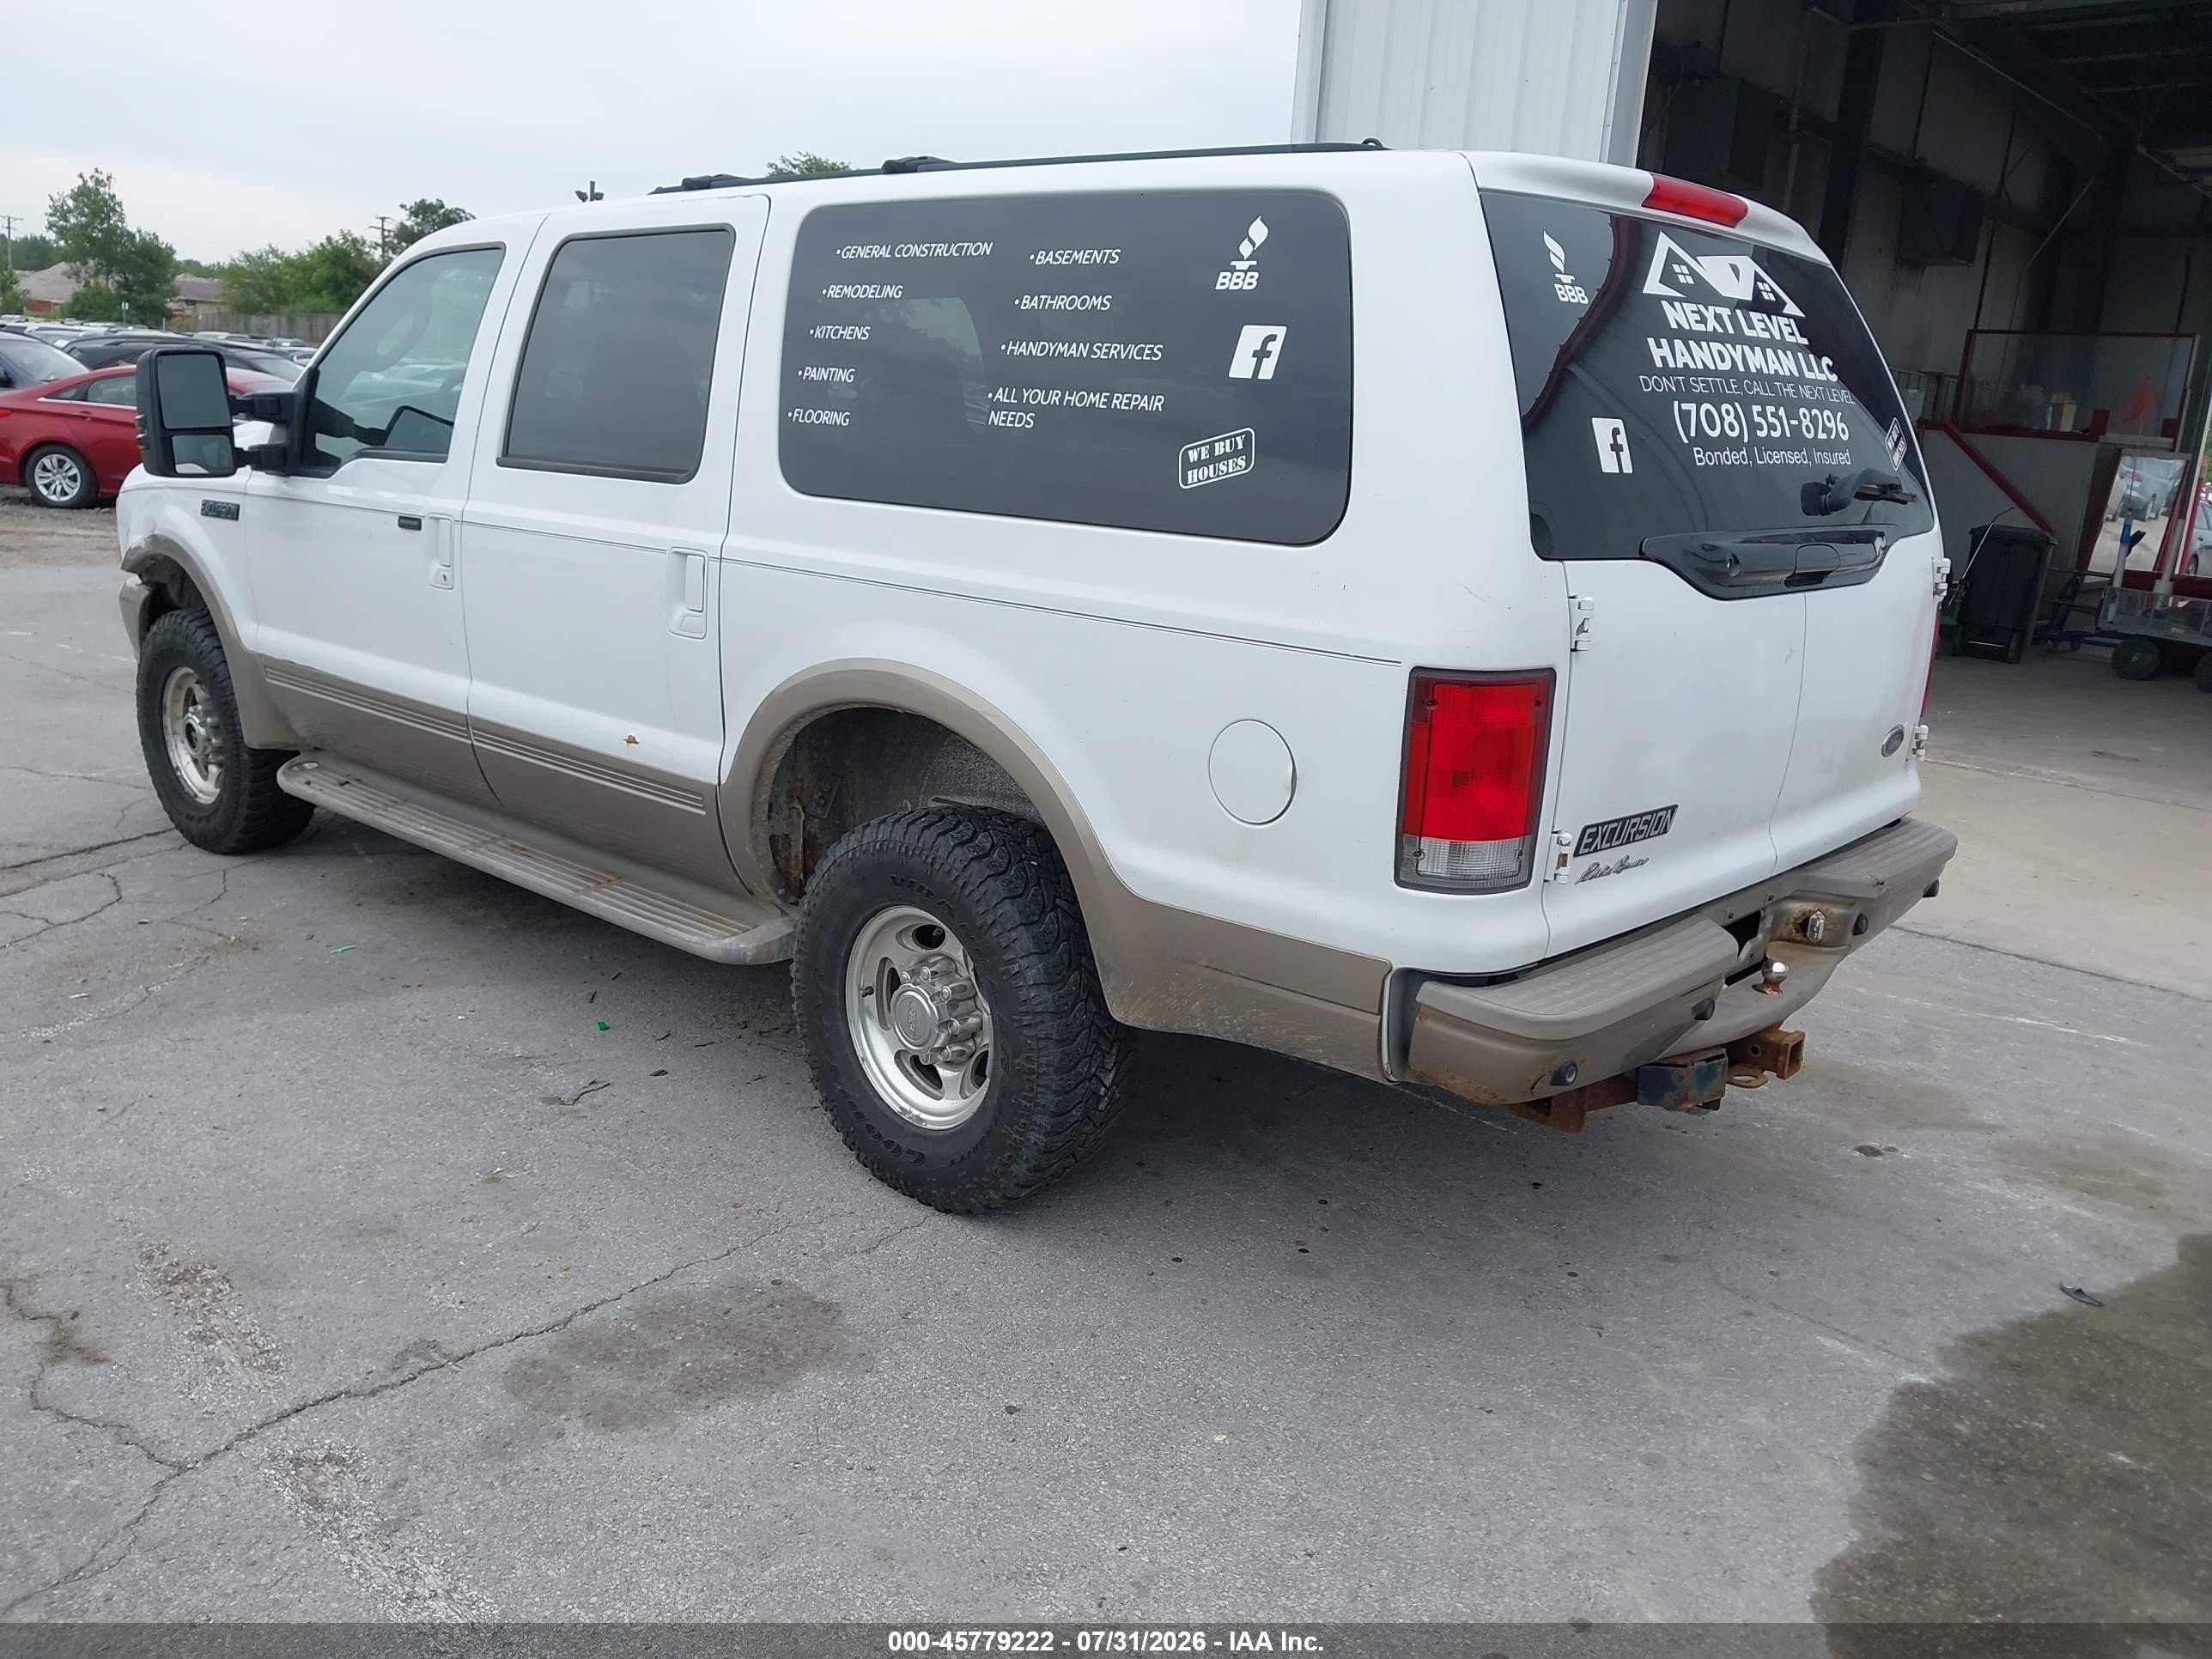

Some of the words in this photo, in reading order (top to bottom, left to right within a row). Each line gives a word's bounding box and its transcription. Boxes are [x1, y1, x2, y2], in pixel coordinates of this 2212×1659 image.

[842, 245, 891, 258] GENERAL
[894, 241, 994, 258] CONSTRUCTION
[1035, 249, 1121, 265] BASEMENTS
[1215, 270, 1260, 290] BBB
[827, 284, 903, 299] REMODELING
[1553, 283, 1589, 304] BBB
[1020, 295, 1112, 311] BATHROOMS
[814, 325, 871, 340] KITCHENS
[1661, 300, 1735, 335] NEXT
[1735, 308, 1809, 345] LEVEL
[1006, 341, 1090, 358] HANDYMAN
[1091, 343, 1164, 361] SERVICES
[1646, 337, 1800, 378] HANDYMAN
[1797, 351, 1838, 383] LLC
[803, 367, 855, 384] PAINTING
[994, 386, 1018, 404] ALL
[1023, 388, 1061, 406] YOUR
[1063, 391, 1109, 409] HOME
[1111, 392, 1165, 411] REPAIR
[1638, 375, 1686, 392] DON'T
[1744, 380, 1776, 397] CALL
[1774, 382, 1798, 398] THE
[1798, 384, 1825, 401] NEXT
[1825, 386, 1856, 404] LEVEL
[793, 408, 850, 427] FLOORING
[988, 410, 1036, 428] NEEDS
[1674, 400, 1748, 444] (708)
[1752, 404, 1850, 441] 551-8296
[1188, 445, 1210, 464] WE
[1214, 434, 1247, 457] BUY
[1692, 446, 1753, 468] Bonded,
[1753, 447, 1812, 467] Licensed,
[1813, 448, 1851, 465] Insured
[1187, 455, 1247, 485] HOUSES
[1578, 807, 1678, 855] EXCURSION
